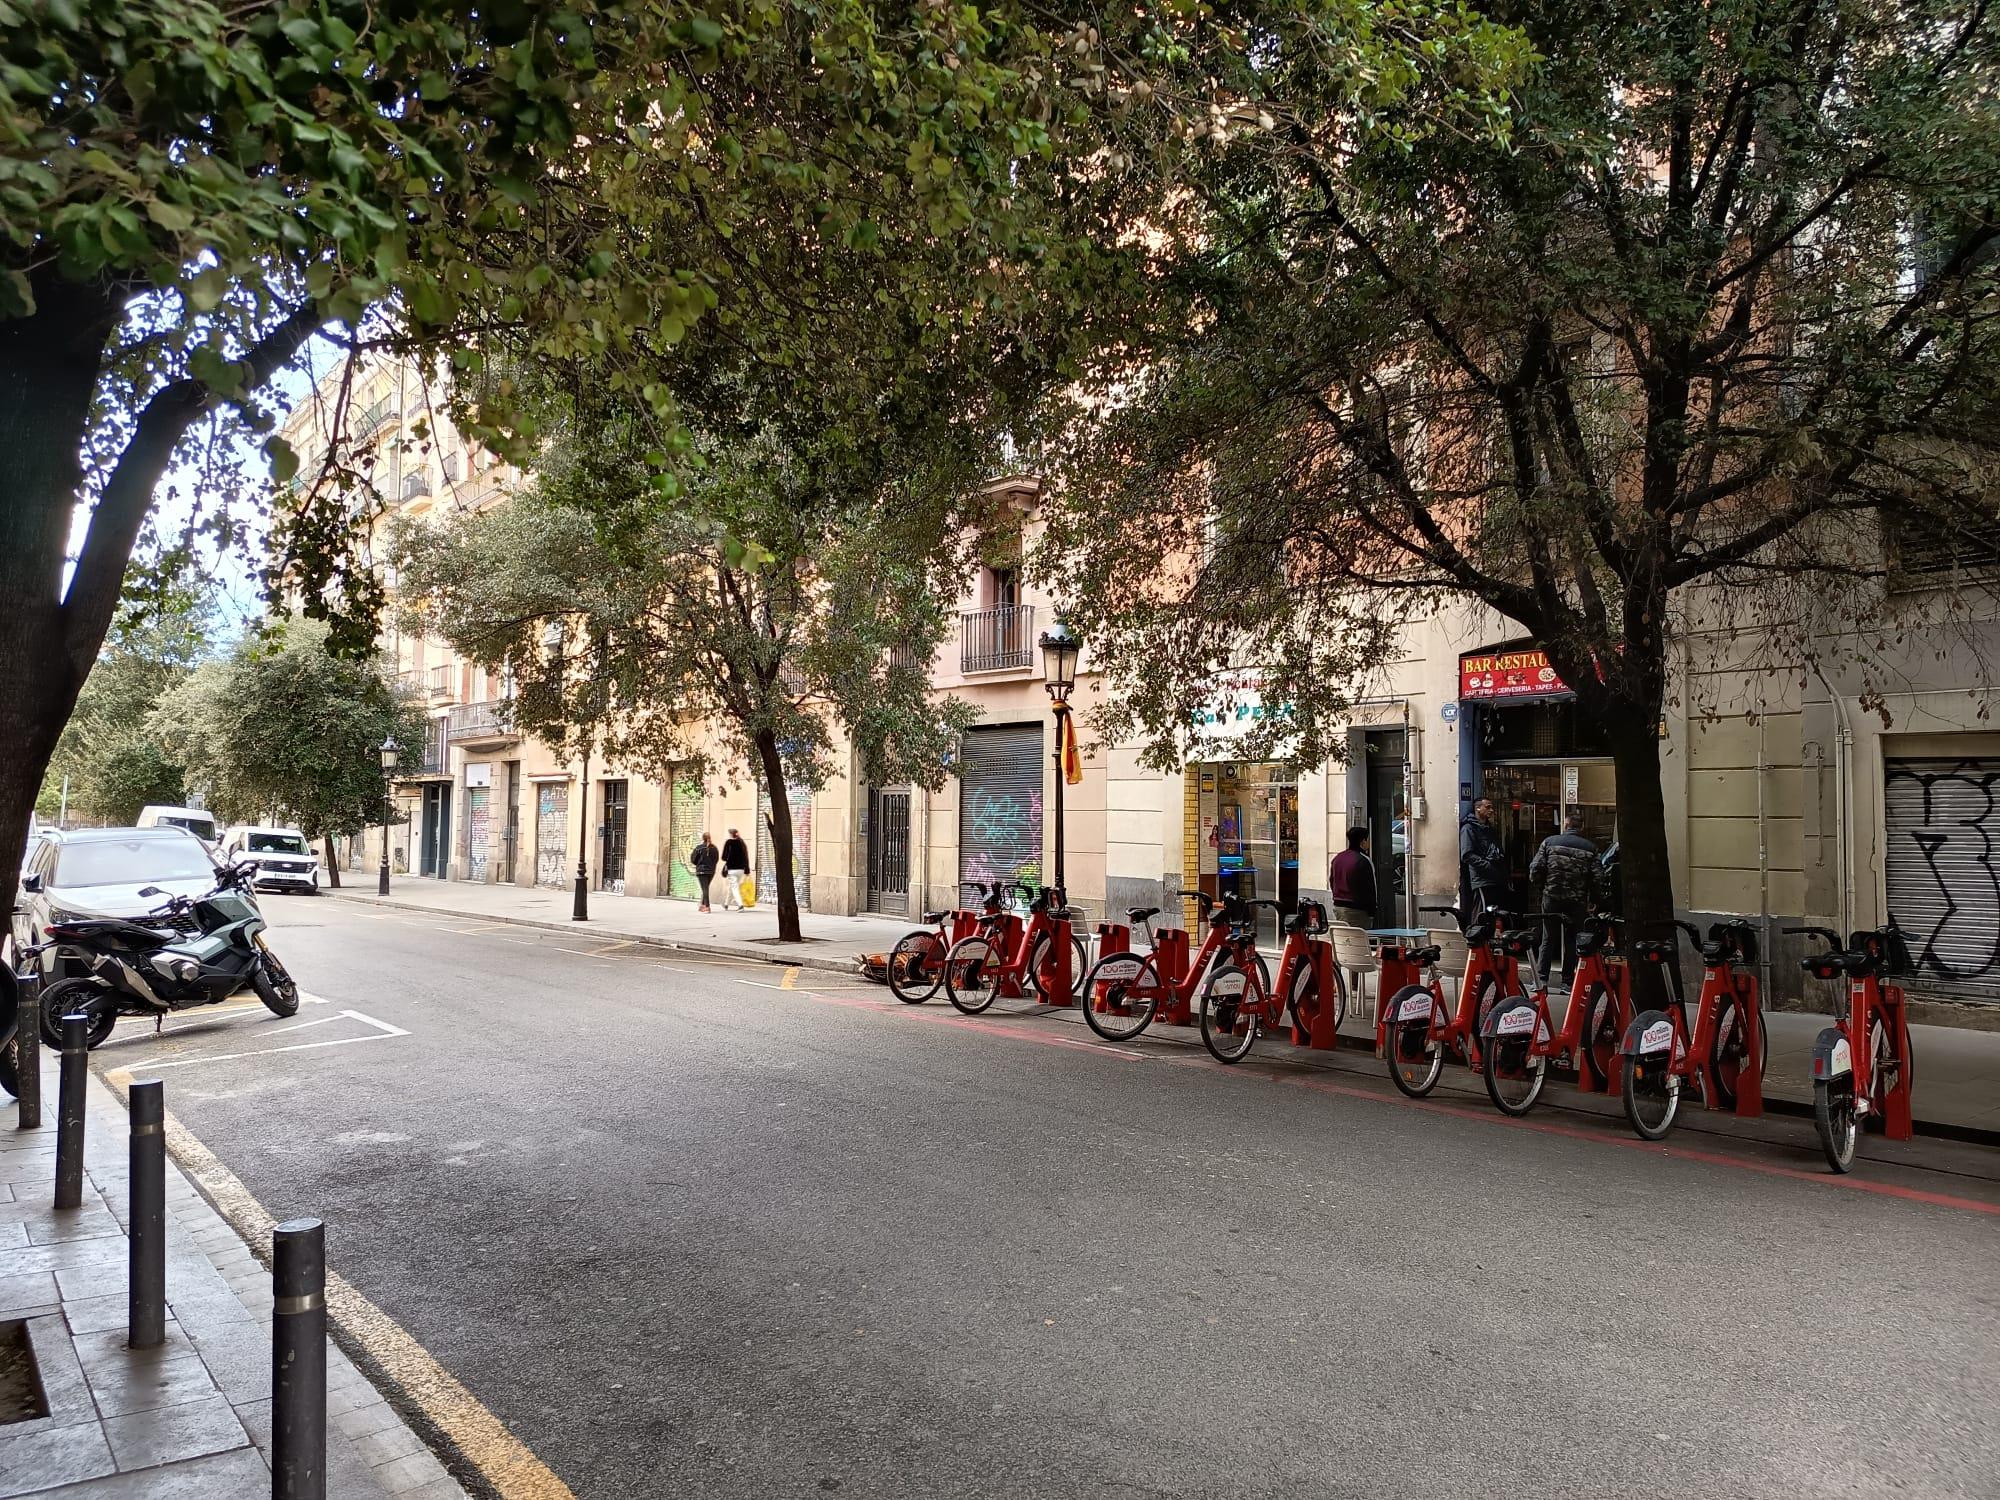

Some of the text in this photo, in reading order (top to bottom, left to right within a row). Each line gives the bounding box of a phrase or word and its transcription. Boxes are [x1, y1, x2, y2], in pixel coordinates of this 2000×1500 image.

[1465, 652, 1551, 674] BAR RESTAU
[1535, 682, 1552, 691] TAPES
[1102, 965, 1118, 974] 100
[1403, 1001, 1416, 1012] 100
[1504, 1014, 1517, 1026] 100
[1644, 1030, 1656, 1045] 100
